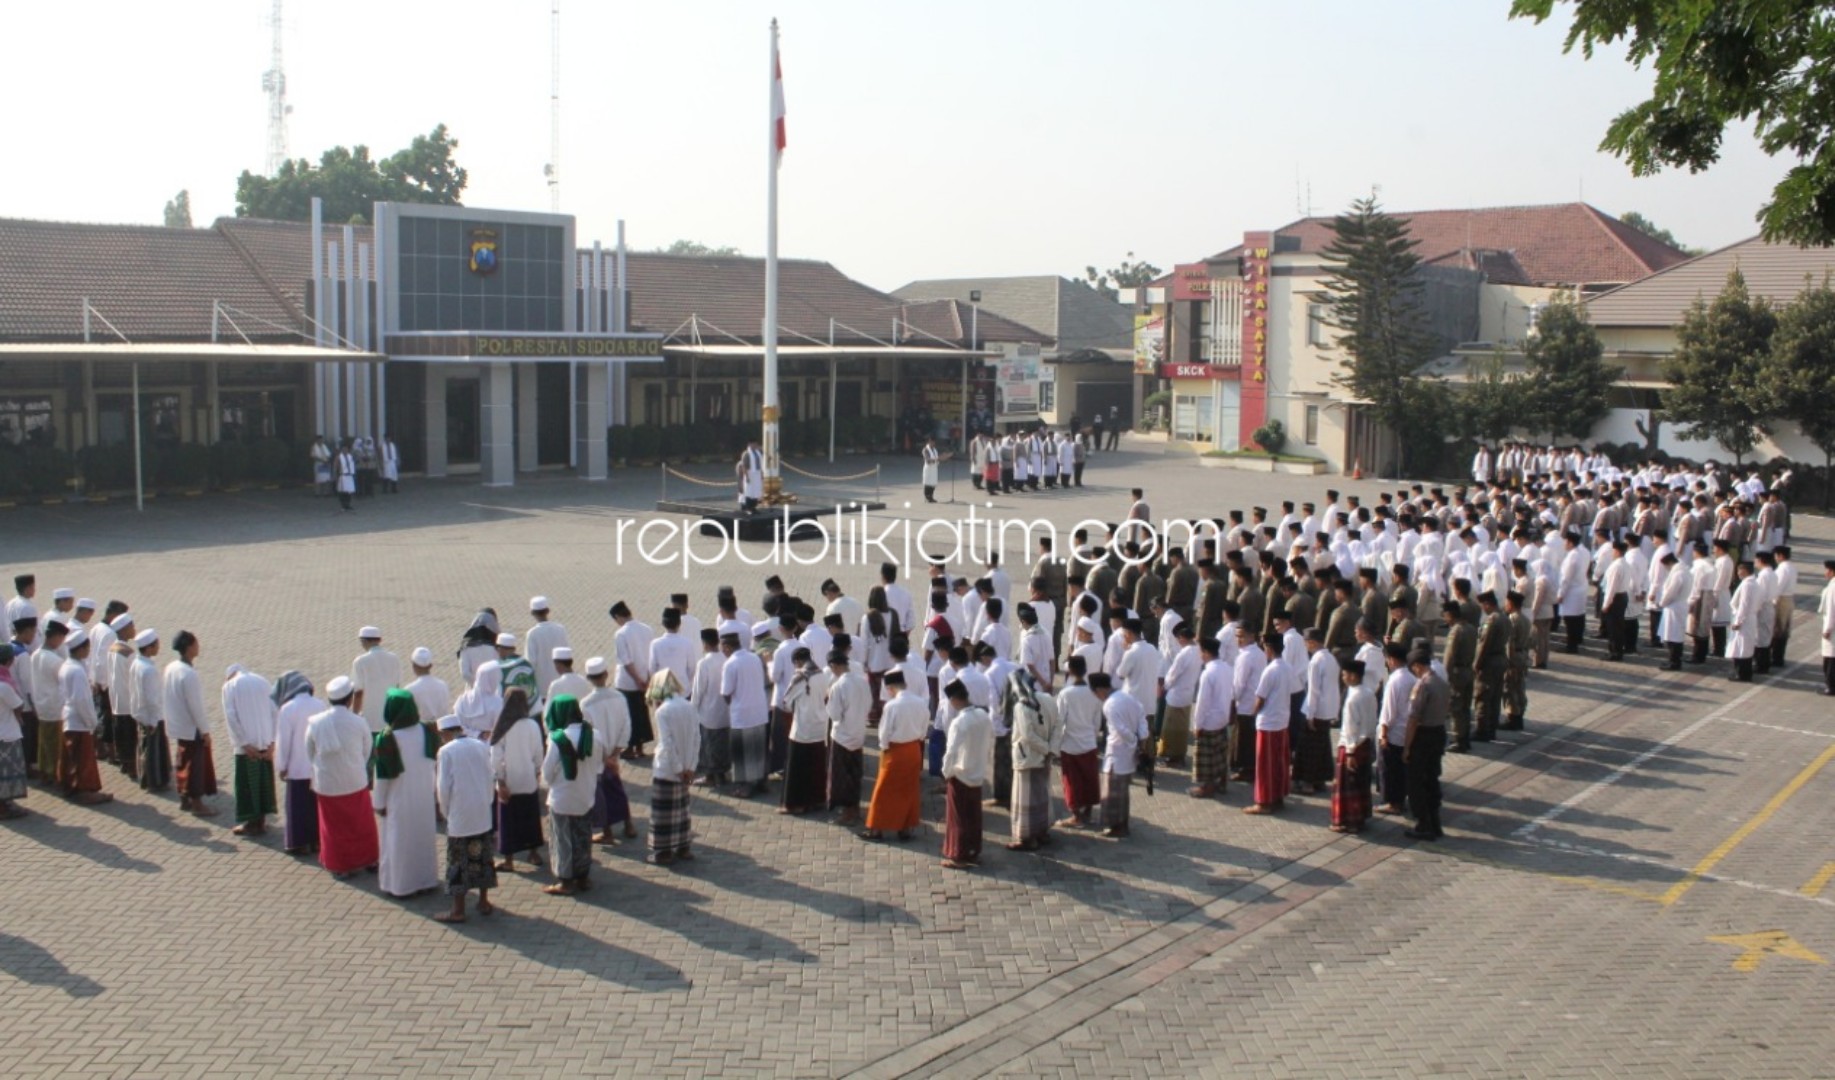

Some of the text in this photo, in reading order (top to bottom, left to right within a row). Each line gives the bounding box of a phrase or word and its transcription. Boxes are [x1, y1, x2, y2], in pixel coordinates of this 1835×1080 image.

[478, 338, 659, 354] POLRESTA SIDOARJO
[1176, 365, 1206, 376] SKCK
